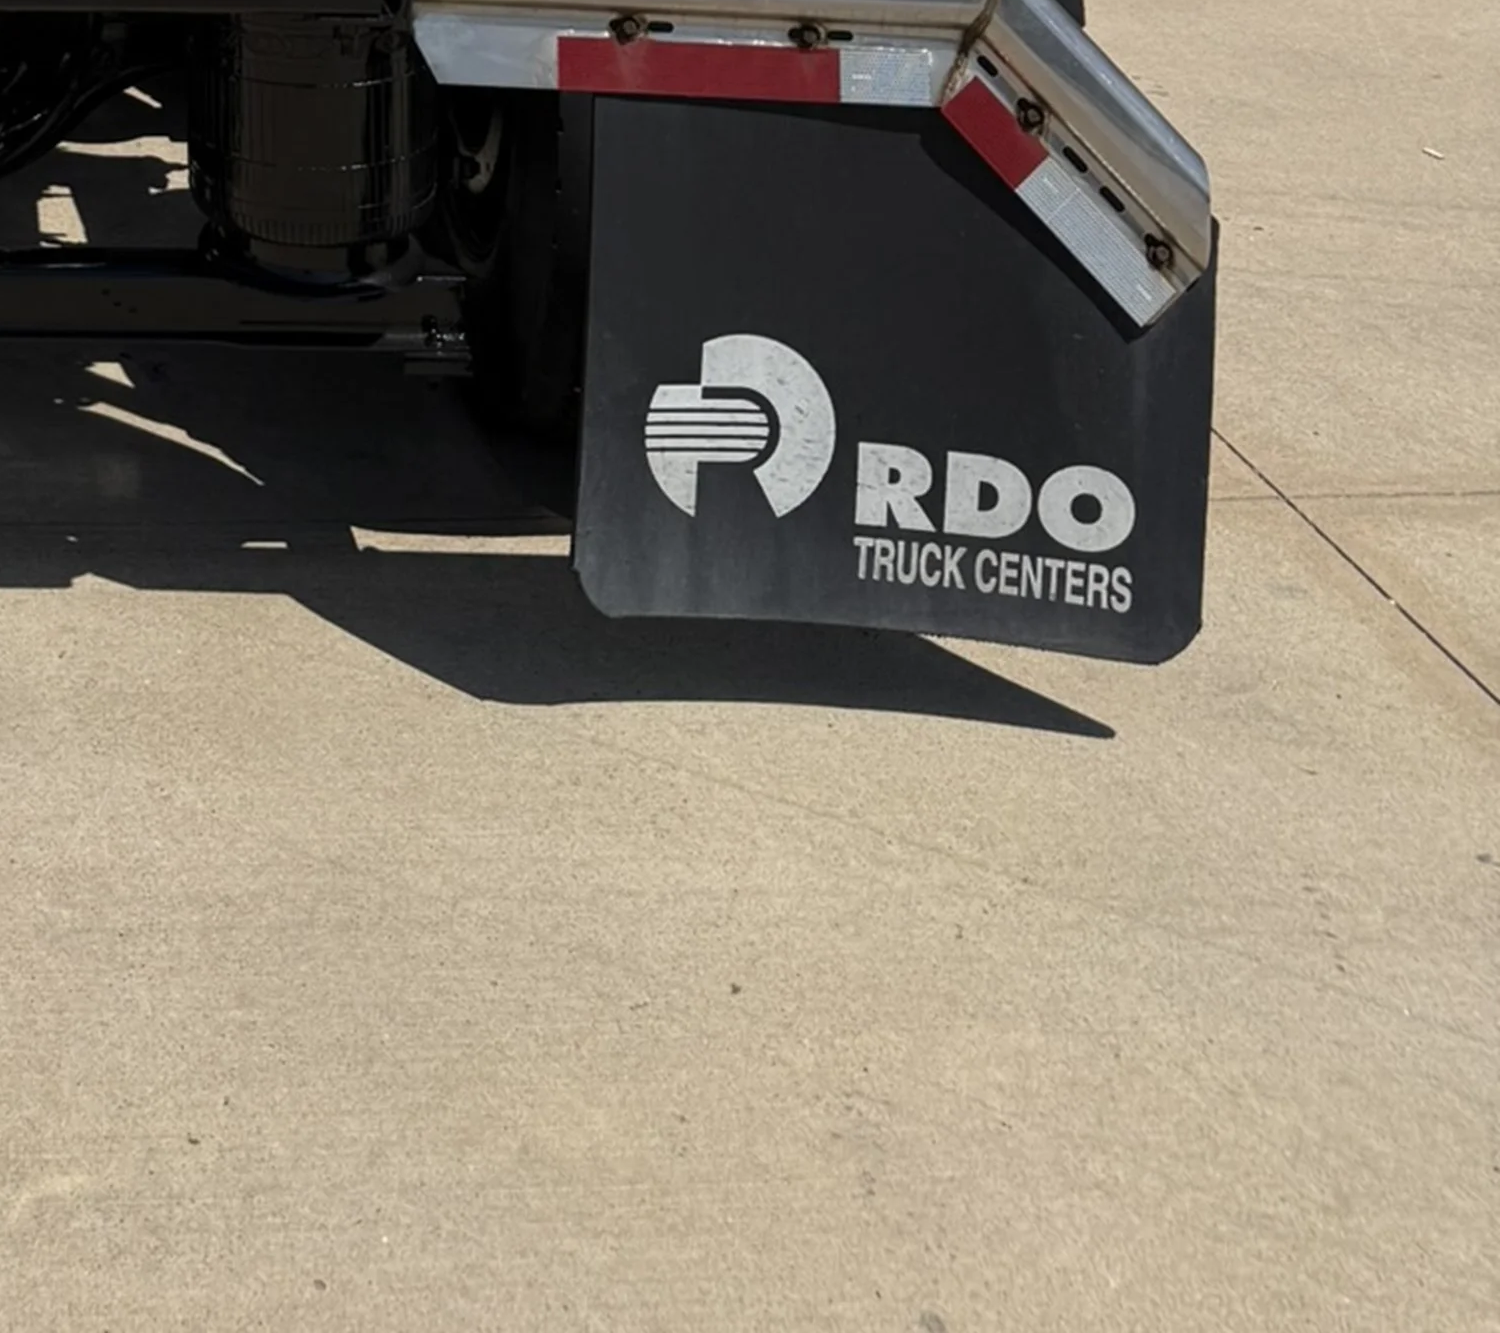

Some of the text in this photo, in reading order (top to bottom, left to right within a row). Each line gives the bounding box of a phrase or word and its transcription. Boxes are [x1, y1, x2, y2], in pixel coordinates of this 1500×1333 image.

[854, 441, 1136, 553] RDO
[853, 536, 1132, 613] TRUCK CENTERS
